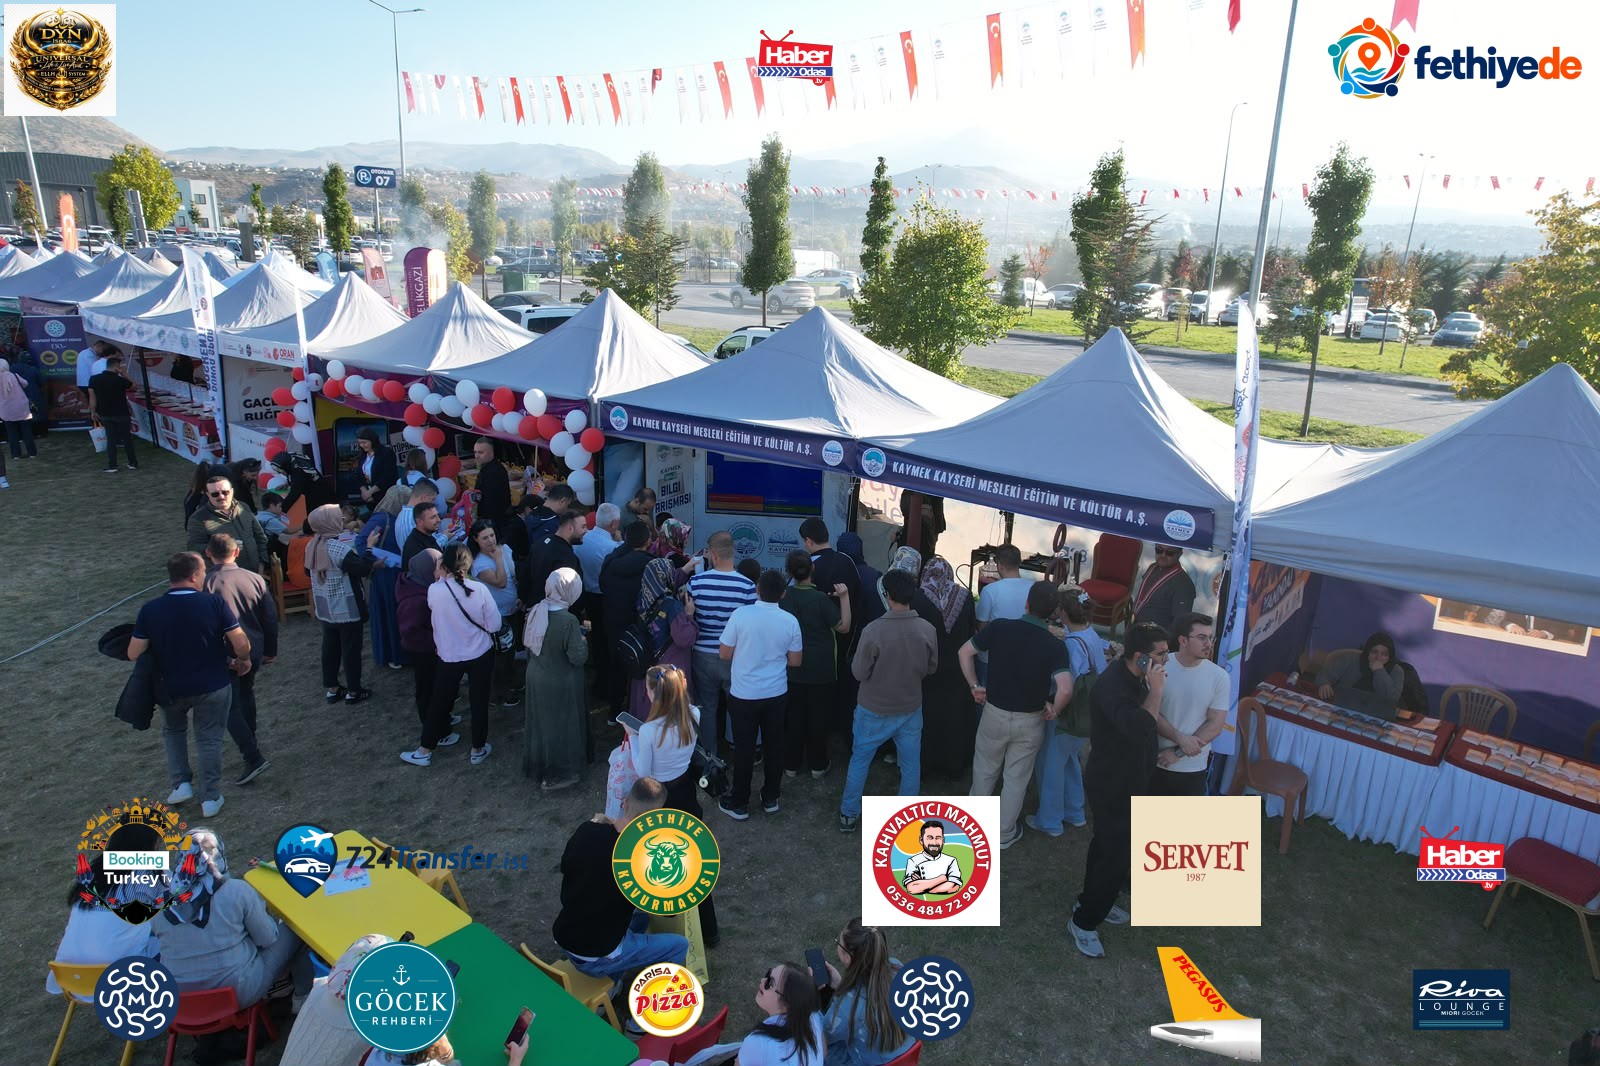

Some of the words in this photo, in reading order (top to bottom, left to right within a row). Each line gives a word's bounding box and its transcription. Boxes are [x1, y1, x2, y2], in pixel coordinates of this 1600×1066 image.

[375, 176, 390, 186] 07
[411, 266, 426, 313] ELİKGAZİ
[280, 348, 294, 358] ORAN
[632, 416, 660, 430] KAYMEK
[662, 421, 691, 435] KAYSERİ
[693, 426, 723, 440] MESLEKİ
[725, 430, 751, 445] EĞİTİM
[753, 435, 762, 447] VE
[764, 436, 794, 452] KÜLTÜR
[796, 442, 813, 456] A.Ş.
[655, 492, 692, 513] ARIŞMASI
[892, 461, 930, 480] KAYMEK
[933, 470, 976, 489] KAYSERİ
[978, 479, 1021, 499] MESLEKİ
[1023, 486, 1060, 507] EĞİTİM
[1063, 496, 1077, 511] VE
[1080, 499, 1122, 521] KÜLTÜR
[1126, 509, 1149, 527] A.Ş.
